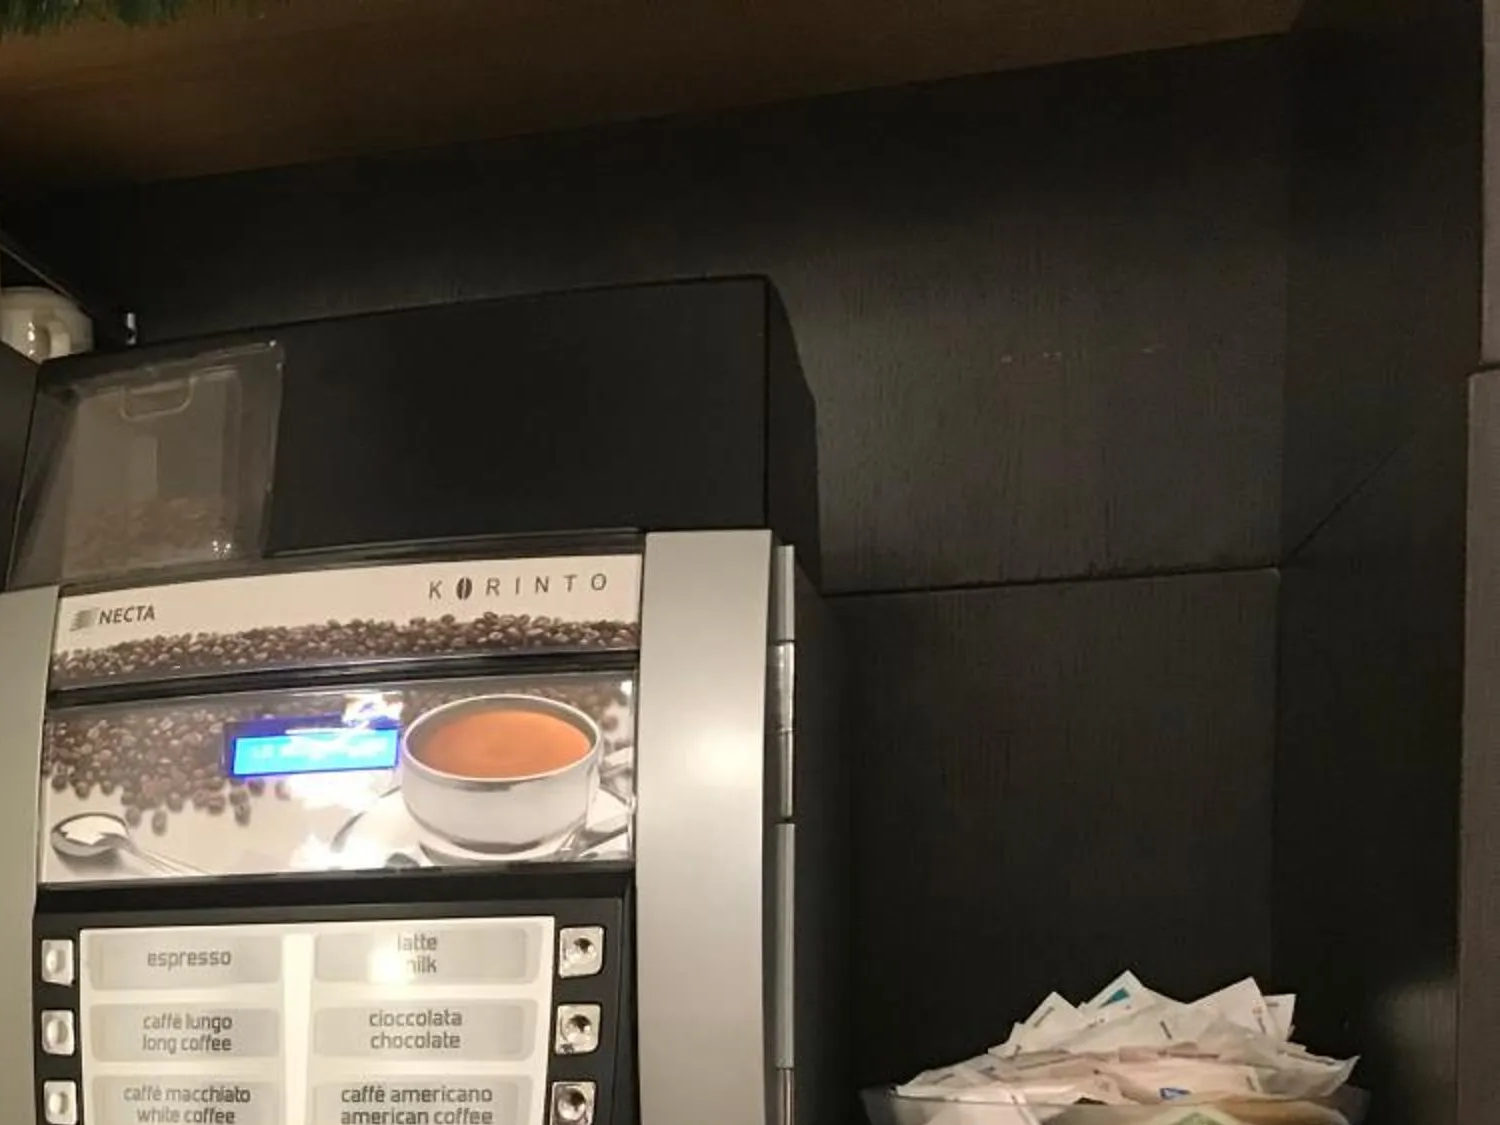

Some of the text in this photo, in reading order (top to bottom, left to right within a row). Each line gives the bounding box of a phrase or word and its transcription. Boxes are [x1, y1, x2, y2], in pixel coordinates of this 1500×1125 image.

[428, 572, 607, 600] KORINTO
[99, 604, 155, 624] NECTA
[397, 933, 438, 951] latte
[147, 951, 232, 971] espresso
[185, 1013, 233, 1034] lungo
[369, 1009, 462, 1027] cioccolata
[142, 1034, 233, 1055] long coffee
[371, 1031, 461, 1049] chocolate
[165, 1085, 251, 1103] macchiato
[341, 1085, 493, 1103] caffè americano
[137, 1106, 236, 1124] white coffee
[340, 1108, 493, 1125] american coffee
